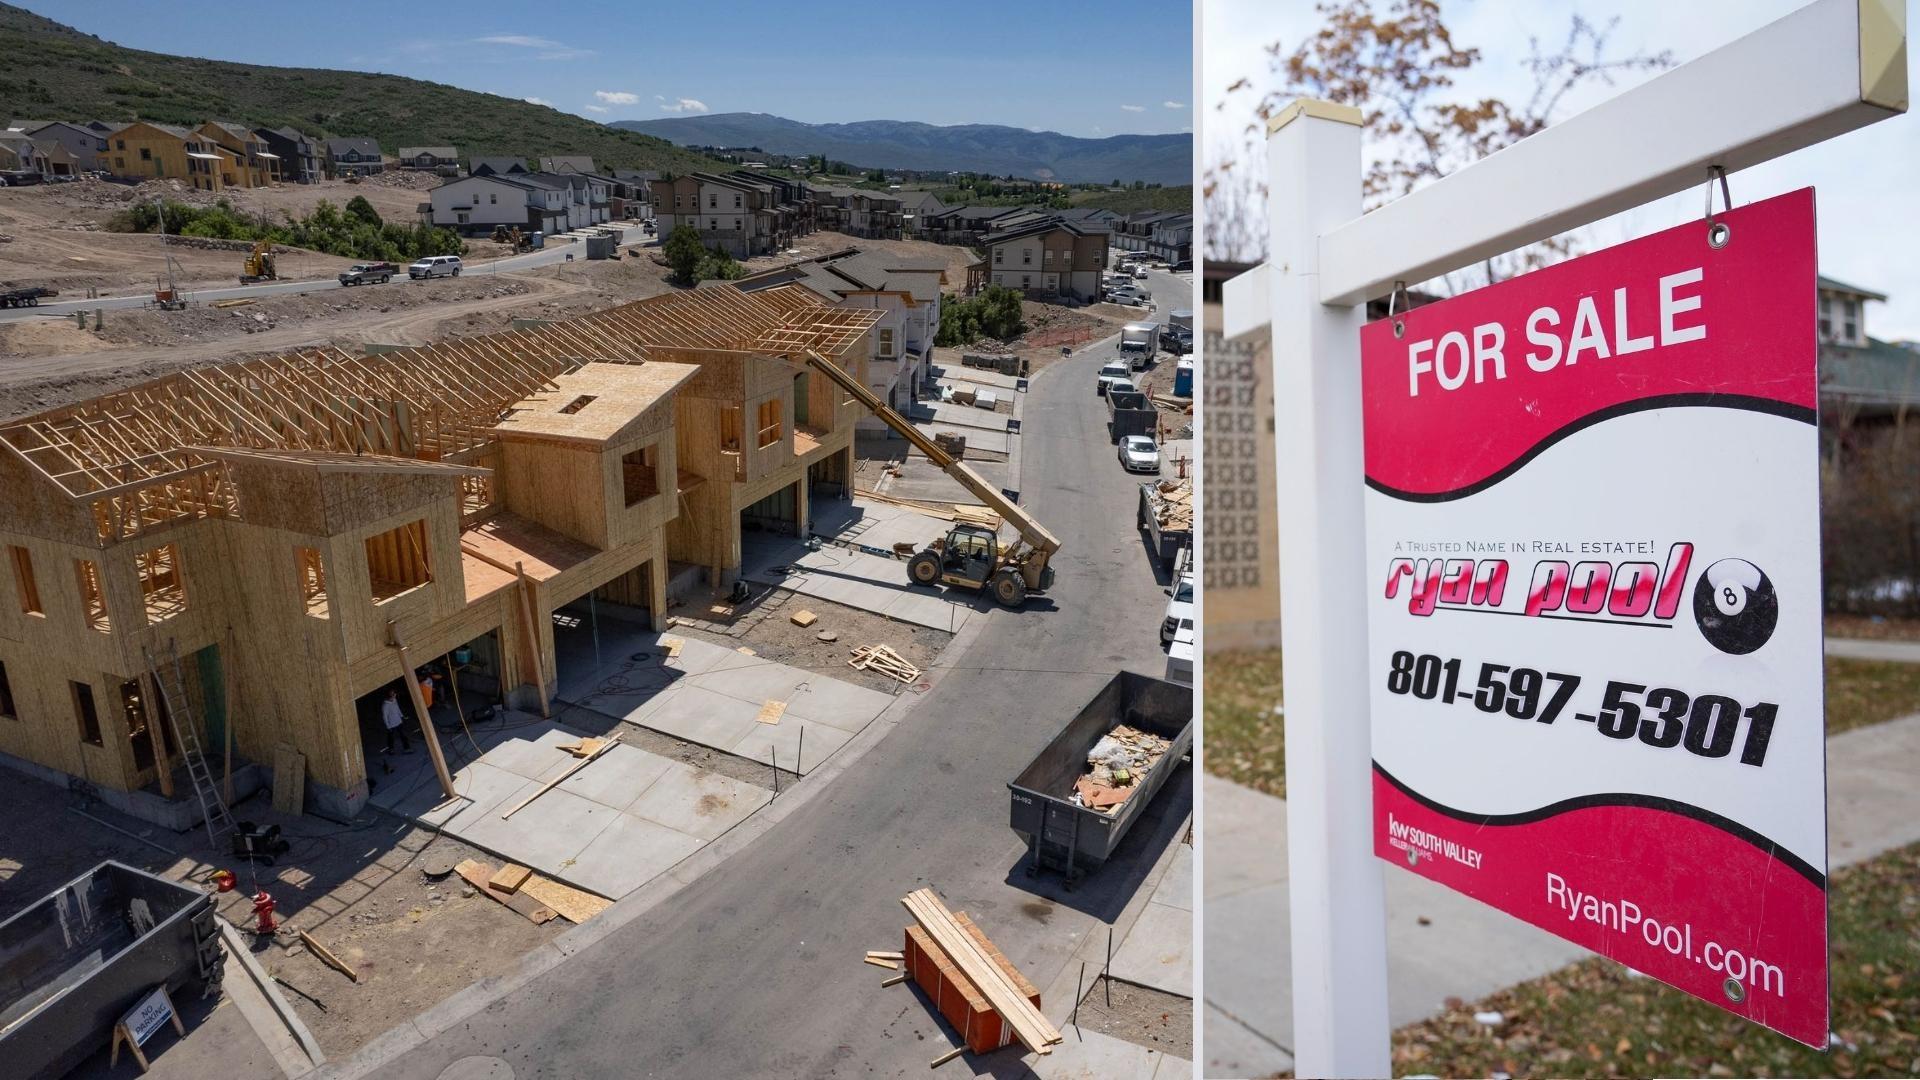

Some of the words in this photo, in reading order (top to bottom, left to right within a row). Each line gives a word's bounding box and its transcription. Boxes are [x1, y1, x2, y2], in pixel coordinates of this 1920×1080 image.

[1408, 321, 1507, 397] FOR
[1525, 266, 1707, 373] SALE
[1394, 542, 1402, 551] A
[1385, 557, 1509, 617] ryan
[1524, 541, 1694, 619] pool
[1723, 587, 1738, 606] 8
[1386, 650, 1780, 768] 801-597-5301
[1409, 827, 1442, 855] SOUTH
[1443, 839, 1482, 870] VALLEY
[1547, 872, 1784, 998] RyanPool.com
[135, 1001, 167, 1035] PARKING
[141, 1004, 153, 1019] NO
